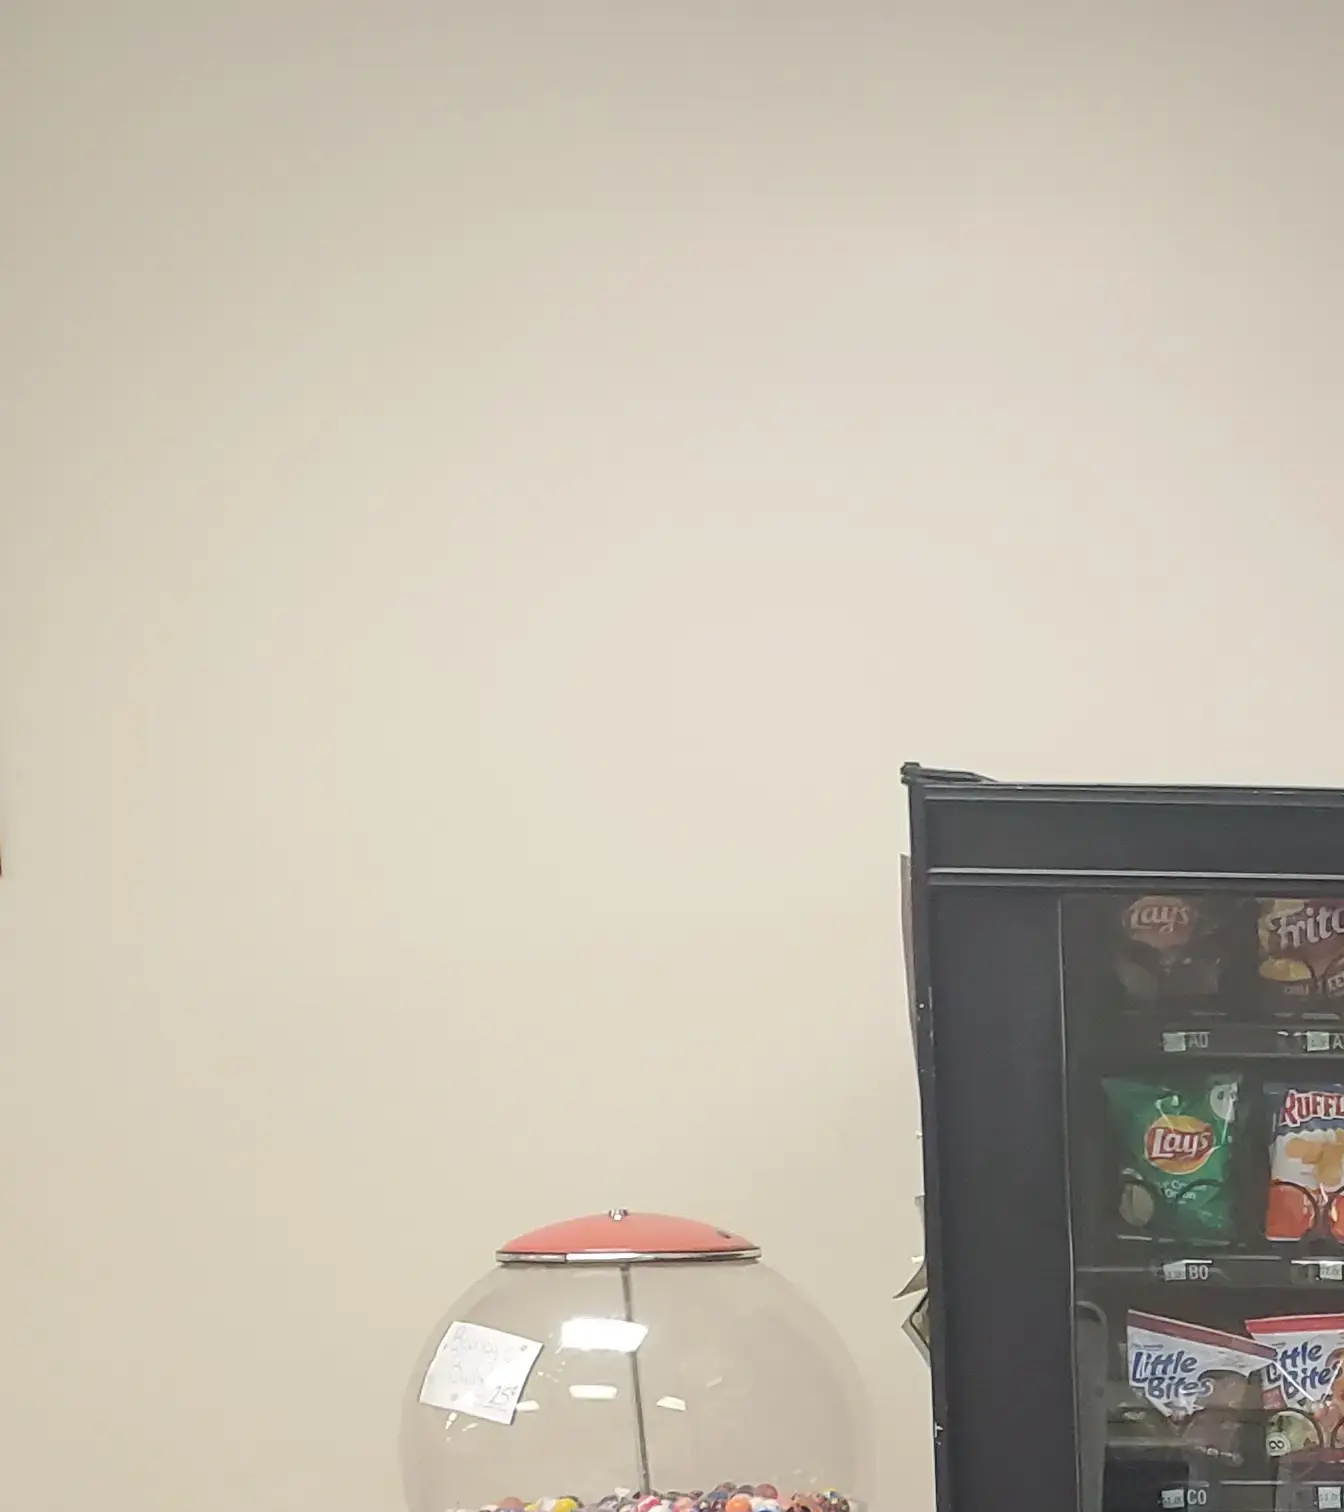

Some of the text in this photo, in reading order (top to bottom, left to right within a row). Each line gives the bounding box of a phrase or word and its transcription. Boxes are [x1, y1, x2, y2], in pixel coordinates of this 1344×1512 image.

[1188, 1033, 1209, 1048] A0
[1189, 1264, 1209, 1281] B0
[1131, 1350, 1198, 1384] Little
[1148, 1375, 1215, 1399] Bites
[1187, 1489, 1207, 1506] C0
